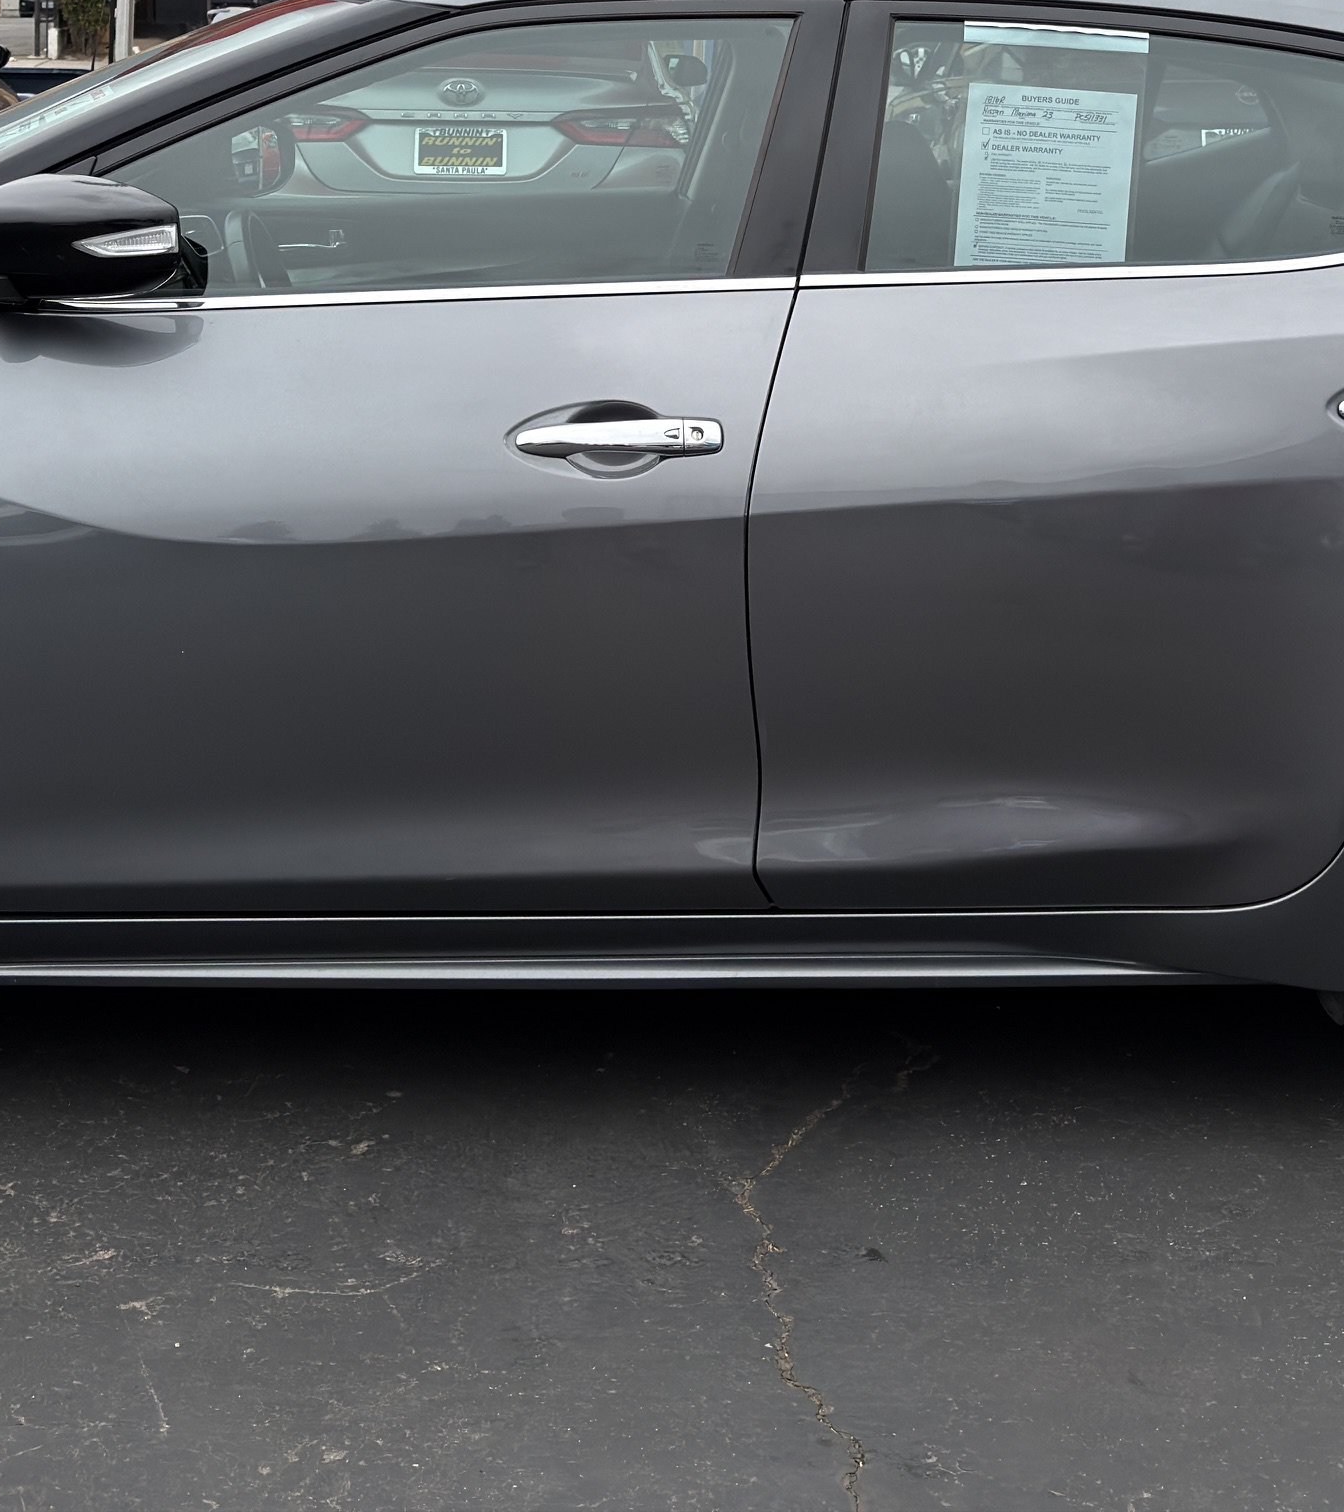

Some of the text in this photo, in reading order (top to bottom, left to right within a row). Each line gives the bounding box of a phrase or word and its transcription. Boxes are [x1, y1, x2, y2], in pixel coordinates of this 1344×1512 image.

[1021, 95, 1080, 106] BUYERS GUIDE
[1041, 111, 1054, 119] 23
[439, 128, 483, 137] BUNNIN
[1029, 131, 1058, 139] DEALER
[1059, 133, 1101, 142] WARRANTY
[992, 144, 1020, 152] DEALER
[1022, 146, 1063, 155] WARRANTY
[421, 157, 497, 166] BUNNIN
